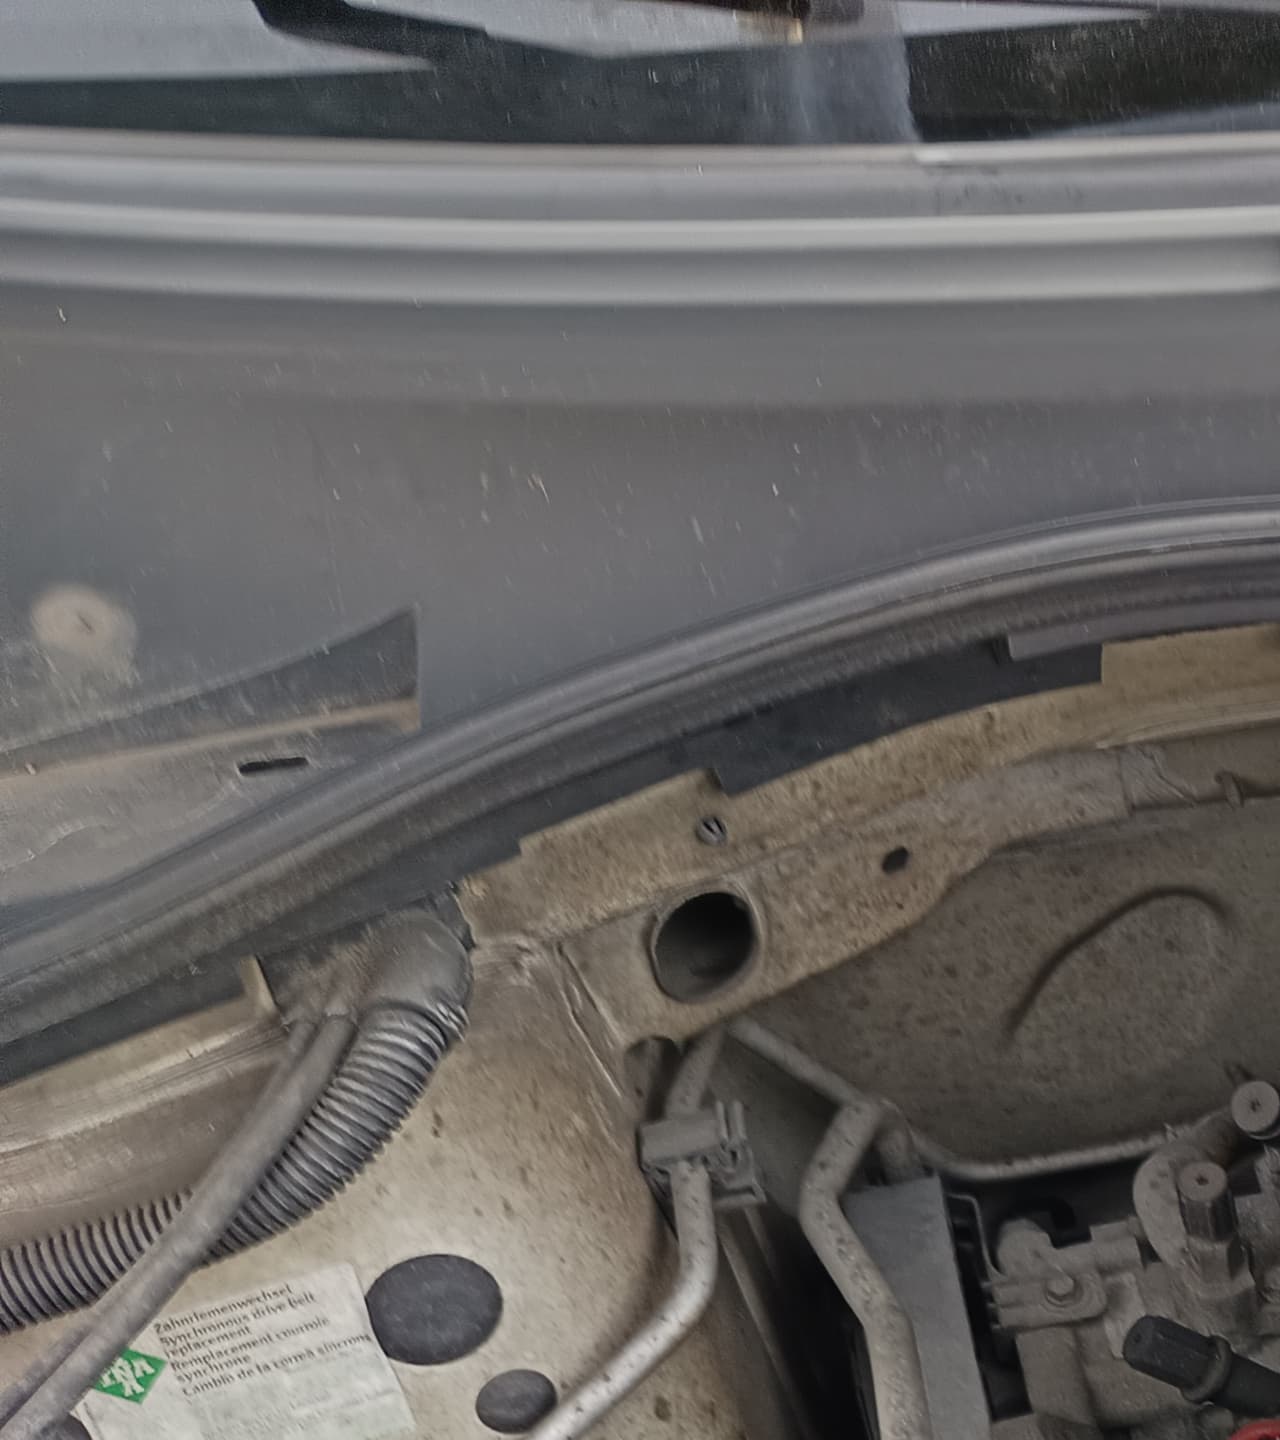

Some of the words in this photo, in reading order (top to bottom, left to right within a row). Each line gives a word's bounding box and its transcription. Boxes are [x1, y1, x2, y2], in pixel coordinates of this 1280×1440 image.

[160, 1314, 250, 1347] Synchronous
[164, 1325, 251, 1360] replacement
[237, 1365, 256, 1380] de
